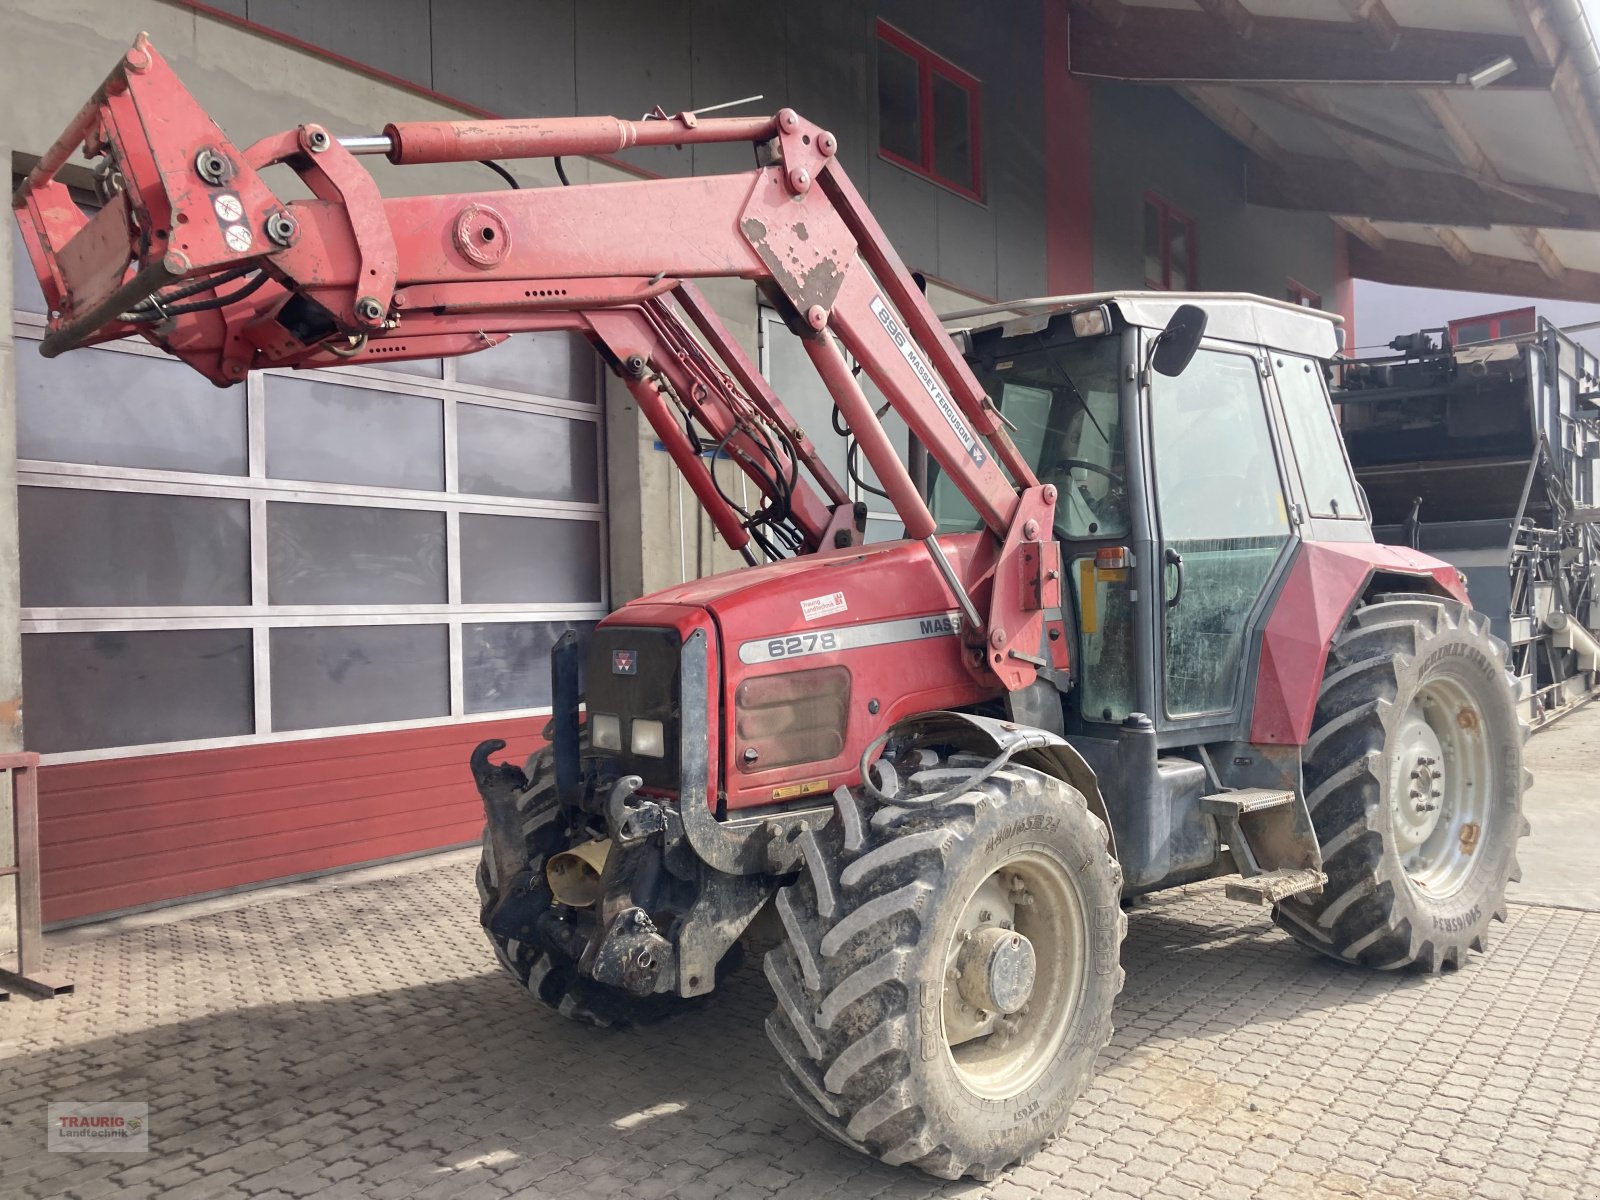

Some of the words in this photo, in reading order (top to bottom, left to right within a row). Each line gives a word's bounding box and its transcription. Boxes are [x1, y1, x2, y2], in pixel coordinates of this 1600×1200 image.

[878, 308, 906, 348] 896
[907, 350, 937, 392] MASSEY
[935, 392, 970, 444] FERGUSON
[920, 616, 963, 634] MASS
[768, 633, 837, 657] 6278
